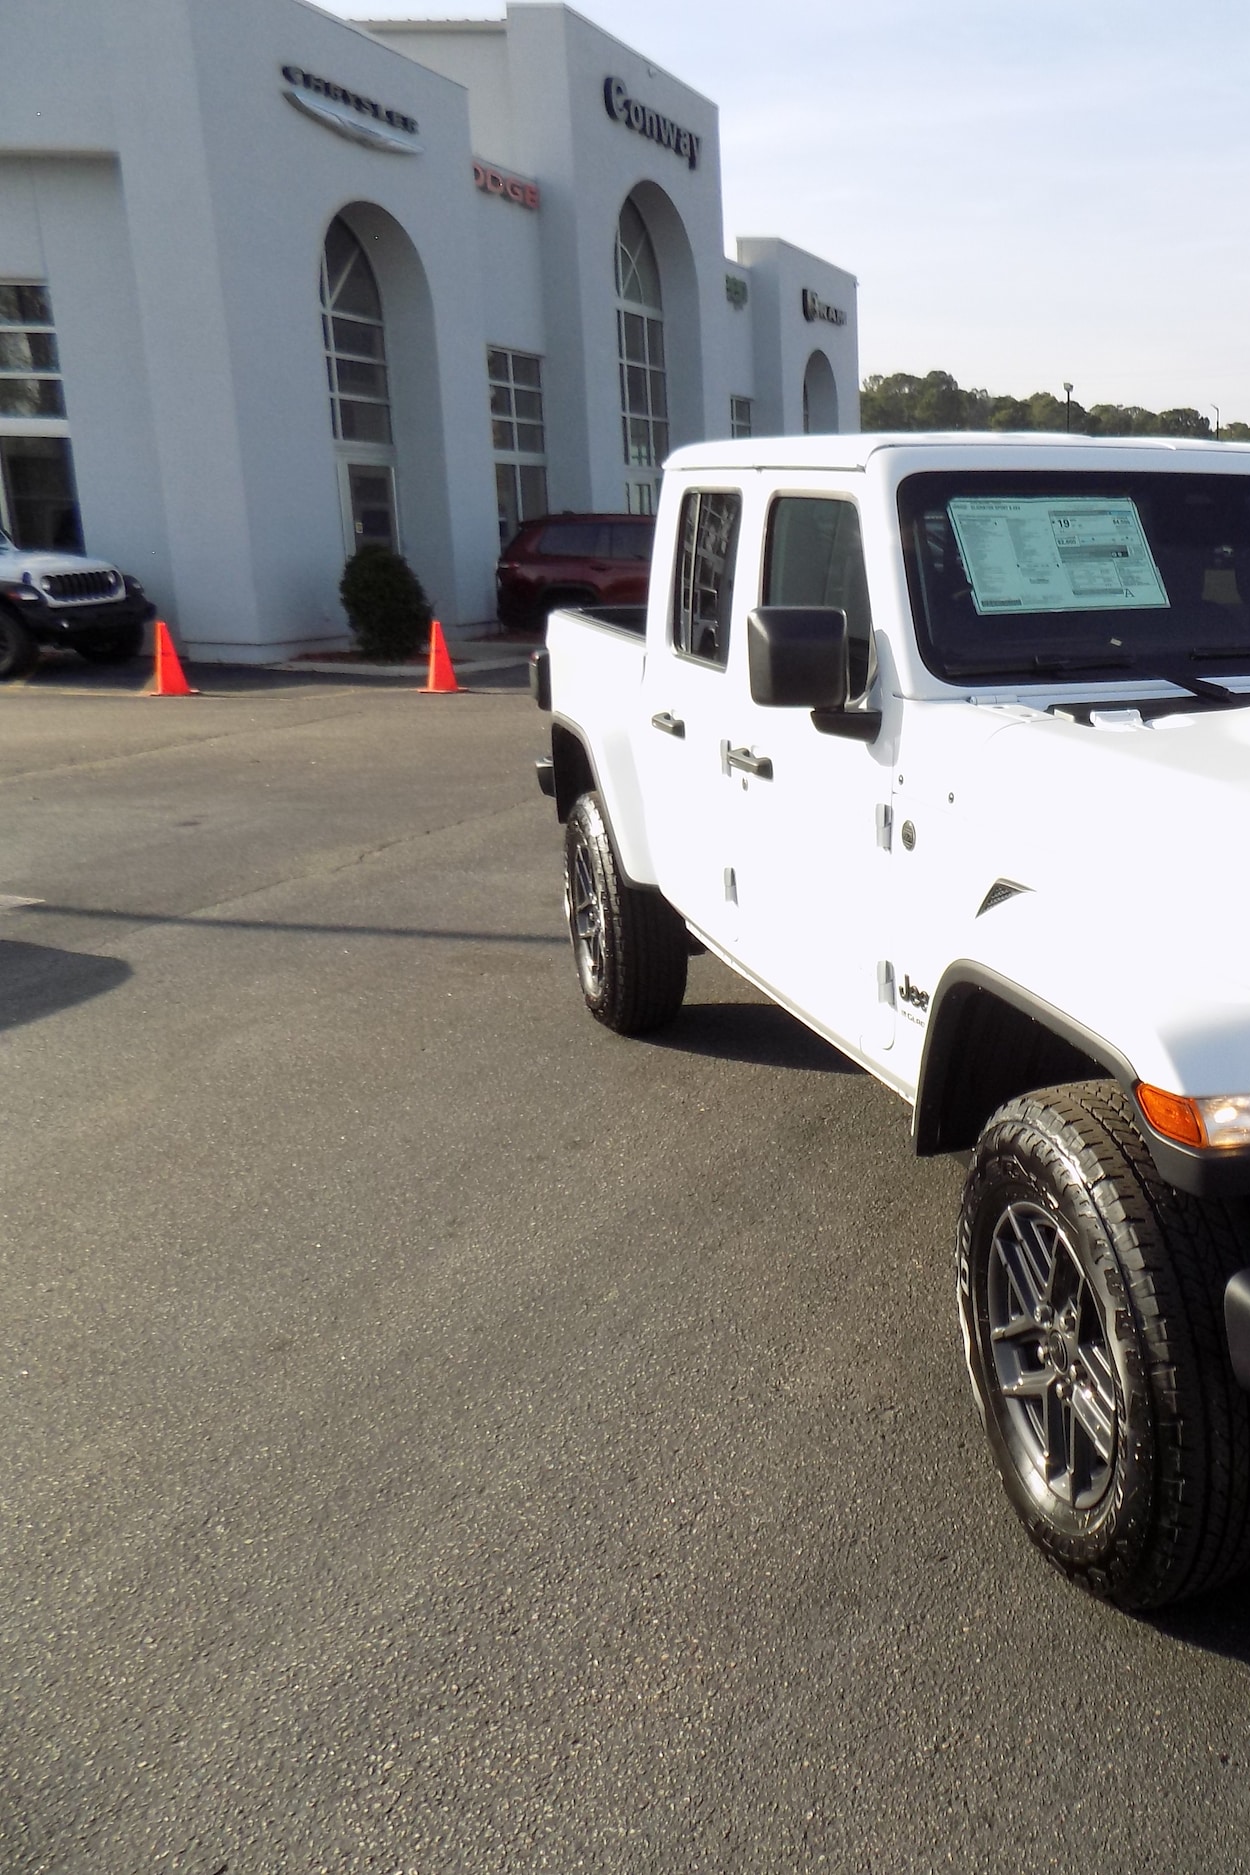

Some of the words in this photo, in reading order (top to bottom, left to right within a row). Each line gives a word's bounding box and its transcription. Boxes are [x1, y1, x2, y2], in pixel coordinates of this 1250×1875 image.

[281, 65, 420, 135] CHRYSLER
[603, 76, 701, 171] Conway
[1057, 519, 1070, 528] 19
[899, 974, 930, 1012] Jee
